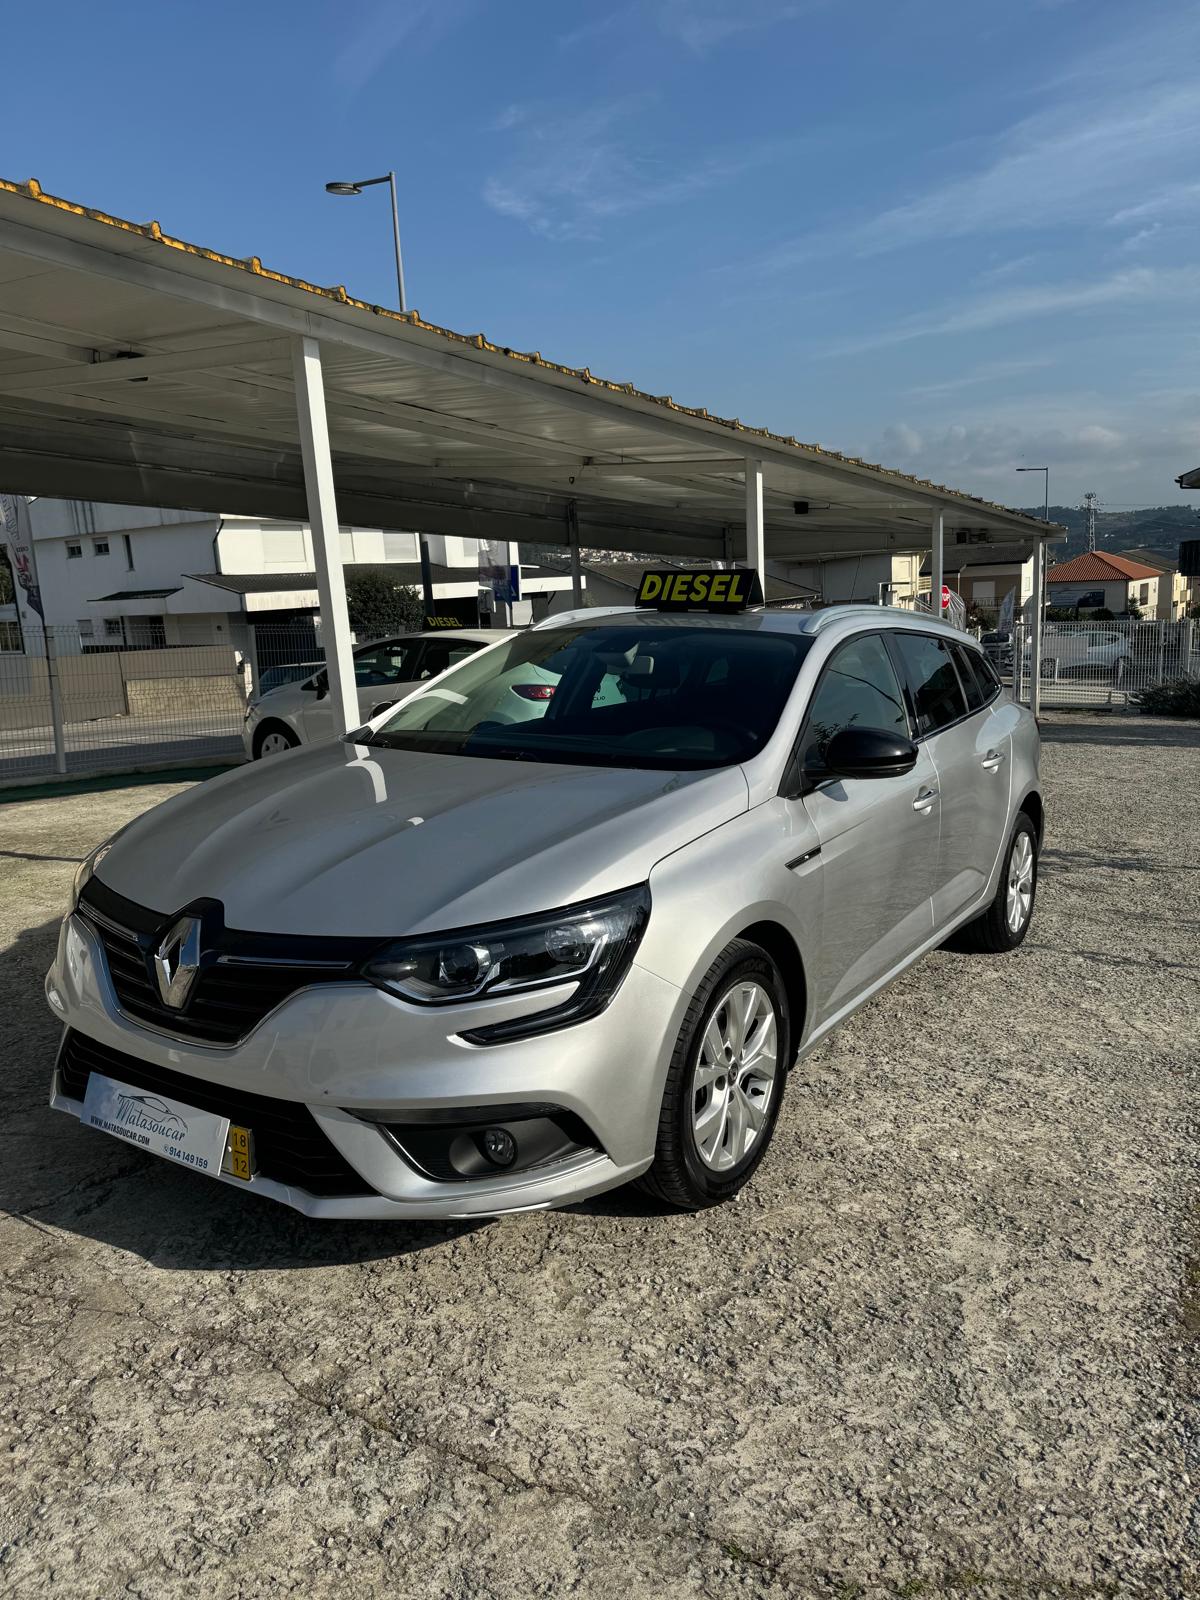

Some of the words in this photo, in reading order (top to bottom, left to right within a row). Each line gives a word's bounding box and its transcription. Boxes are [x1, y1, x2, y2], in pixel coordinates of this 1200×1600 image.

[640, 574, 744, 602] DIESEL
[426, 616, 462, 627] DIESEL
[116, 1095, 186, 1141] Matasoucar
[90, 1114, 151, 1146] WWW.MATASOUCAR.COM
[234, 1132, 246, 1148] 18
[169, 1146, 181, 1158] 914
[182, 1151, 195, 1164] 149
[196, 1156, 208, 1169] 159
[235, 1157, 247, 1173] 12
